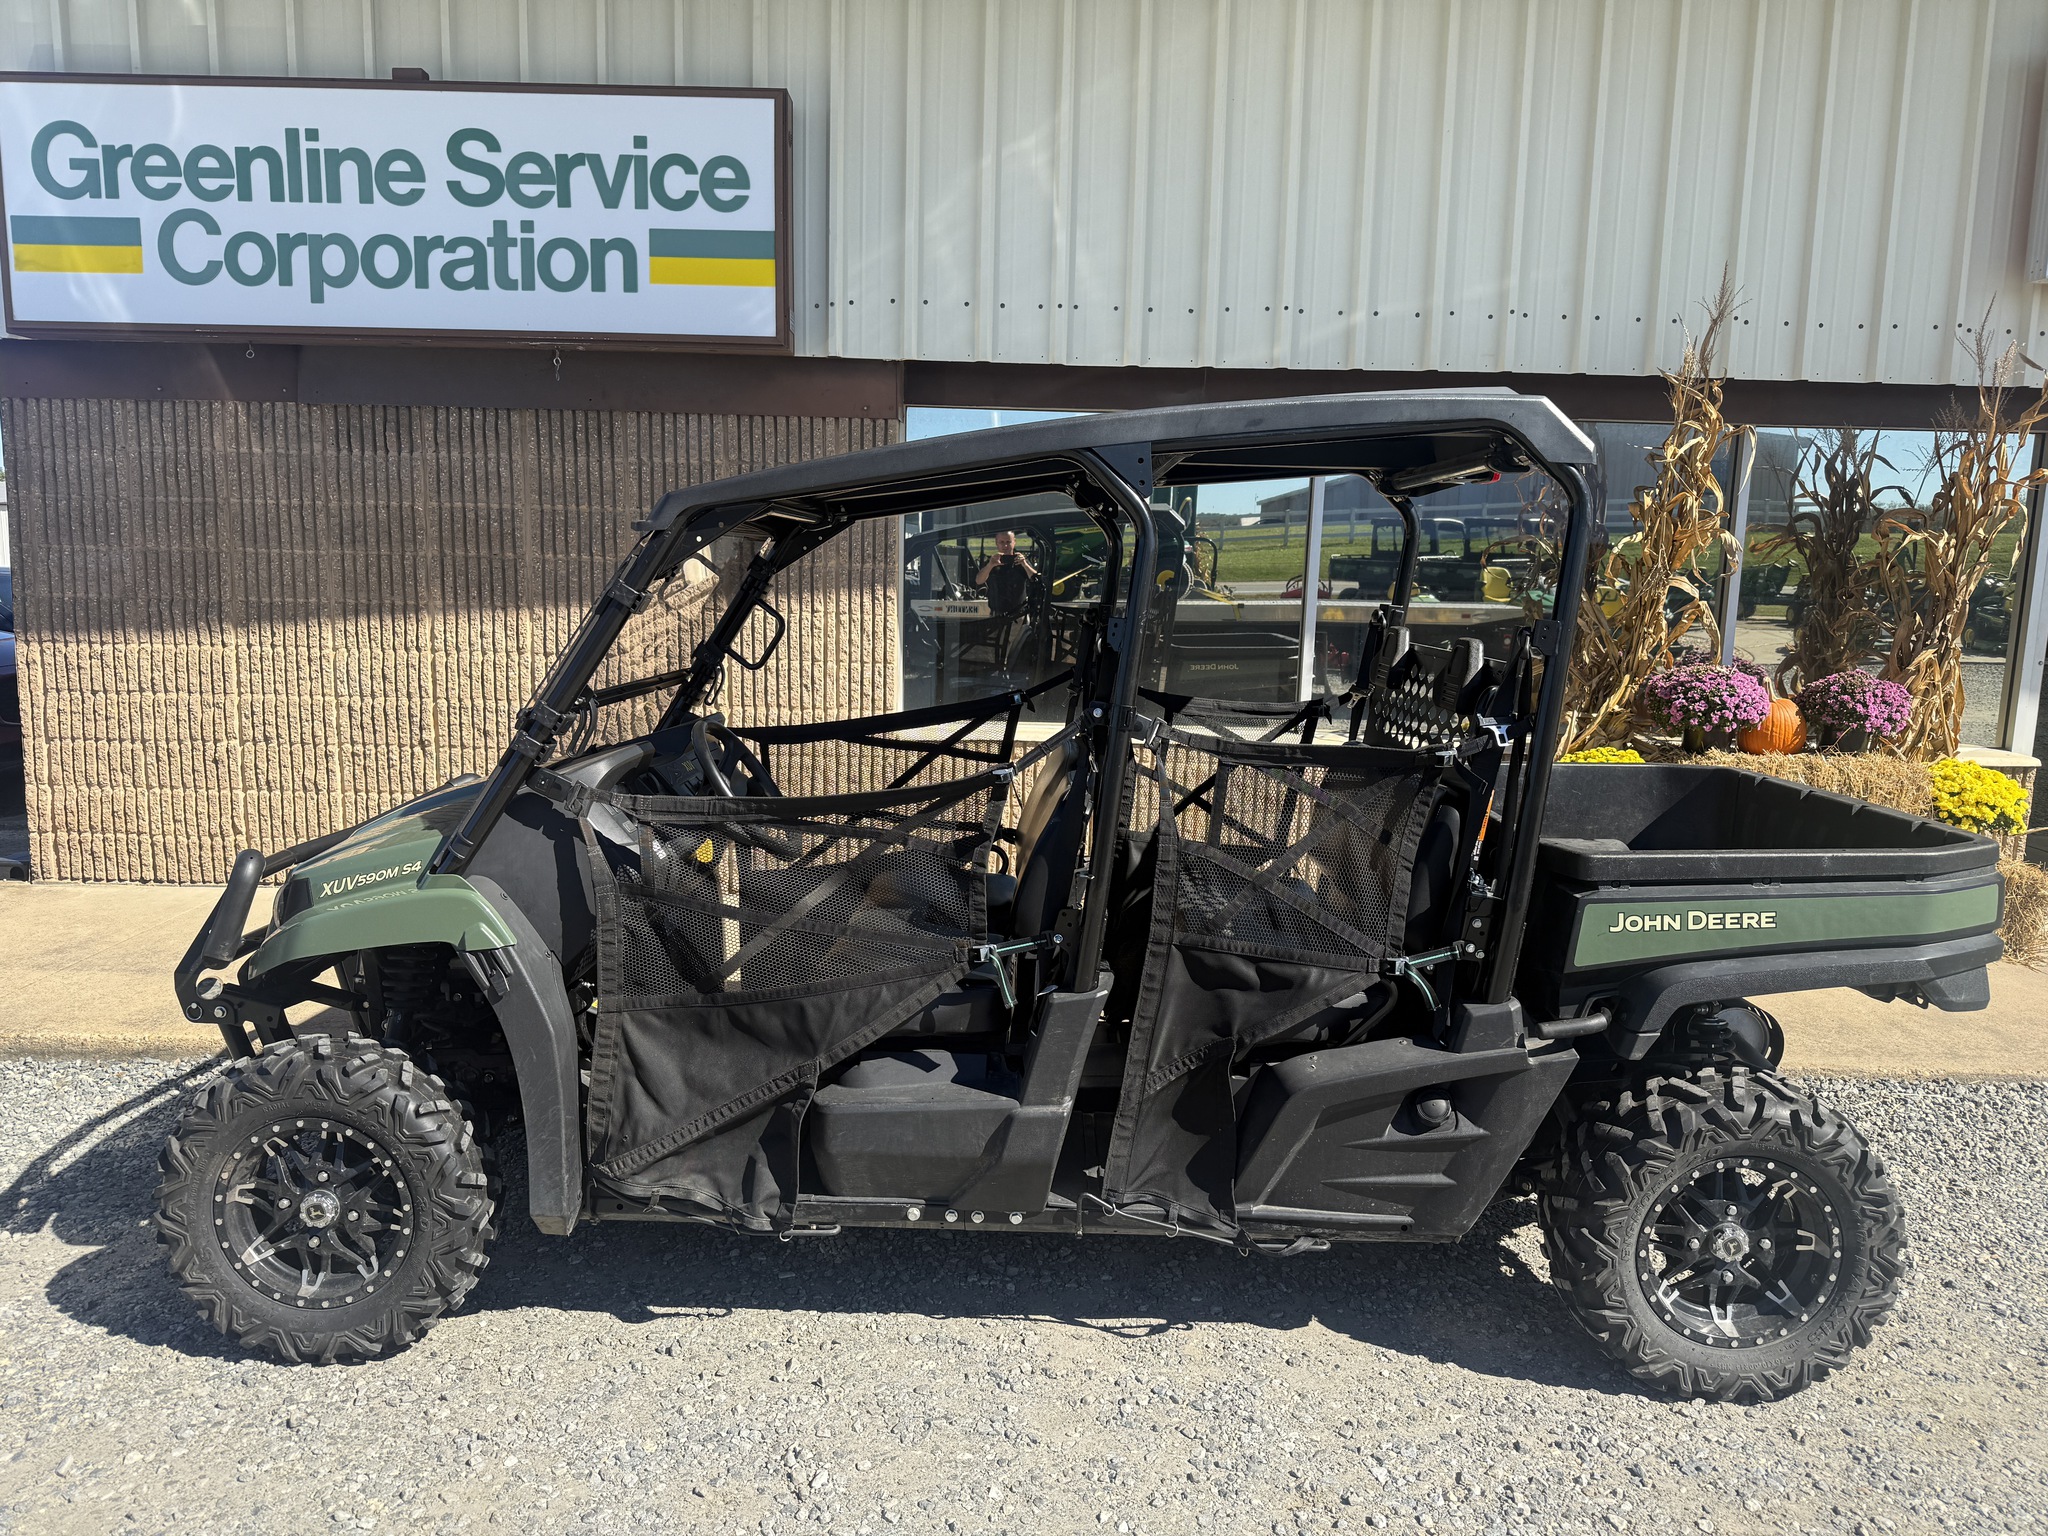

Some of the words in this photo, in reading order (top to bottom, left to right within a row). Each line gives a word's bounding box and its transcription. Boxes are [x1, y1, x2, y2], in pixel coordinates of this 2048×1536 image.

[31, 120, 427, 206] Greenline
[446, 128, 752, 213] Service
[157, 208, 639, 304] Corporation
[319, 866, 399, 898] XUV590M
[401, 860, 423, 876] S4
[1609, 911, 1681, 933] JOHN
[1687, 909, 1778, 931] DEERE
